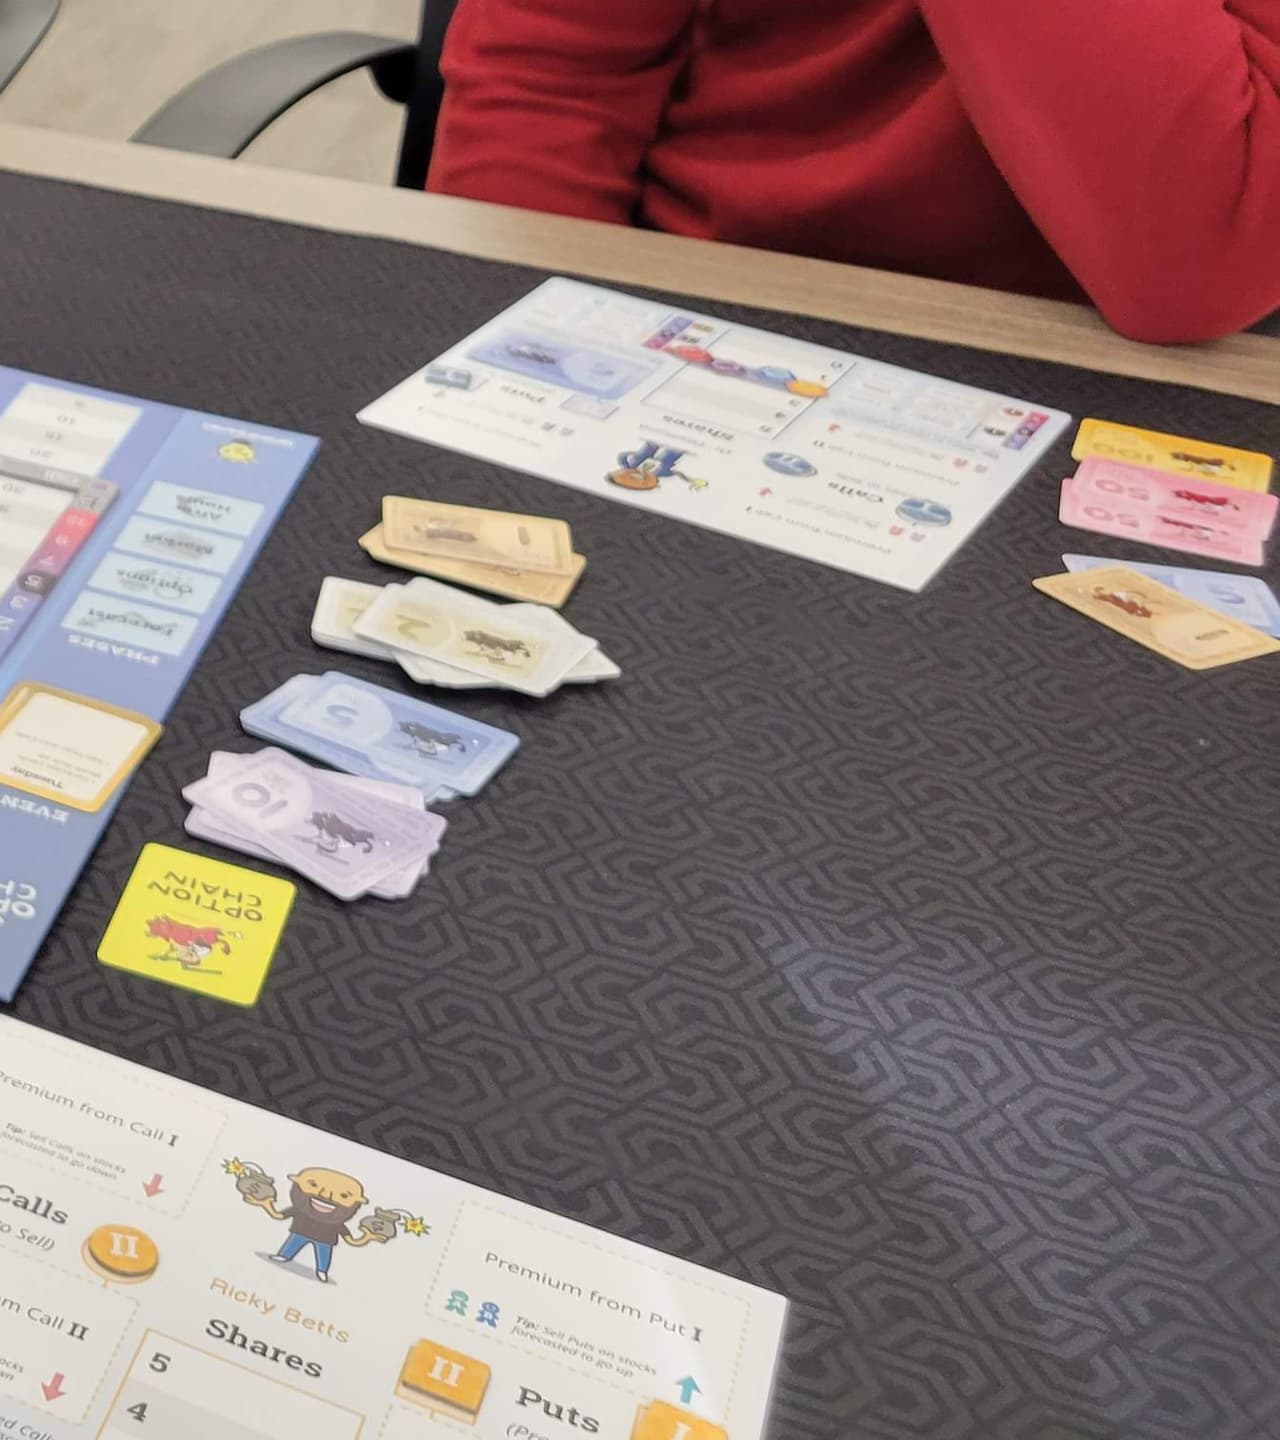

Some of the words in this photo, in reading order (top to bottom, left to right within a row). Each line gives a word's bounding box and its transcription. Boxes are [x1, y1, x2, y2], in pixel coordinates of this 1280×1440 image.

[116, 569, 192, 595] Options
[68, 634, 158, 664] PHASES
[231, 782, 288, 811] 10
[147, 881, 263, 922] OPTION
[164, 871, 262, 907] CHAIN
[79, 1102, 123, 1127] from
[129, 1121, 164, 1141] Call
[15, 1228, 55, 1251] Sell)
[209, 1277, 276, 1315] Ricky
[283, 1307, 349, 1343] Betts
[485, 1252, 581, 1296] Premium
[589, 1290, 641, 1319] from
[648, 1311, 685, 1336] Put
[26, 1307, 64, 1330] Call
[67, 1321, 89, 1341] II
[148, 1352, 171, 1373] 5
[205, 1319, 321, 1377] Shares
[126, 1402, 147, 1423] 4
[515, 1386, 599, 1433] Puts
